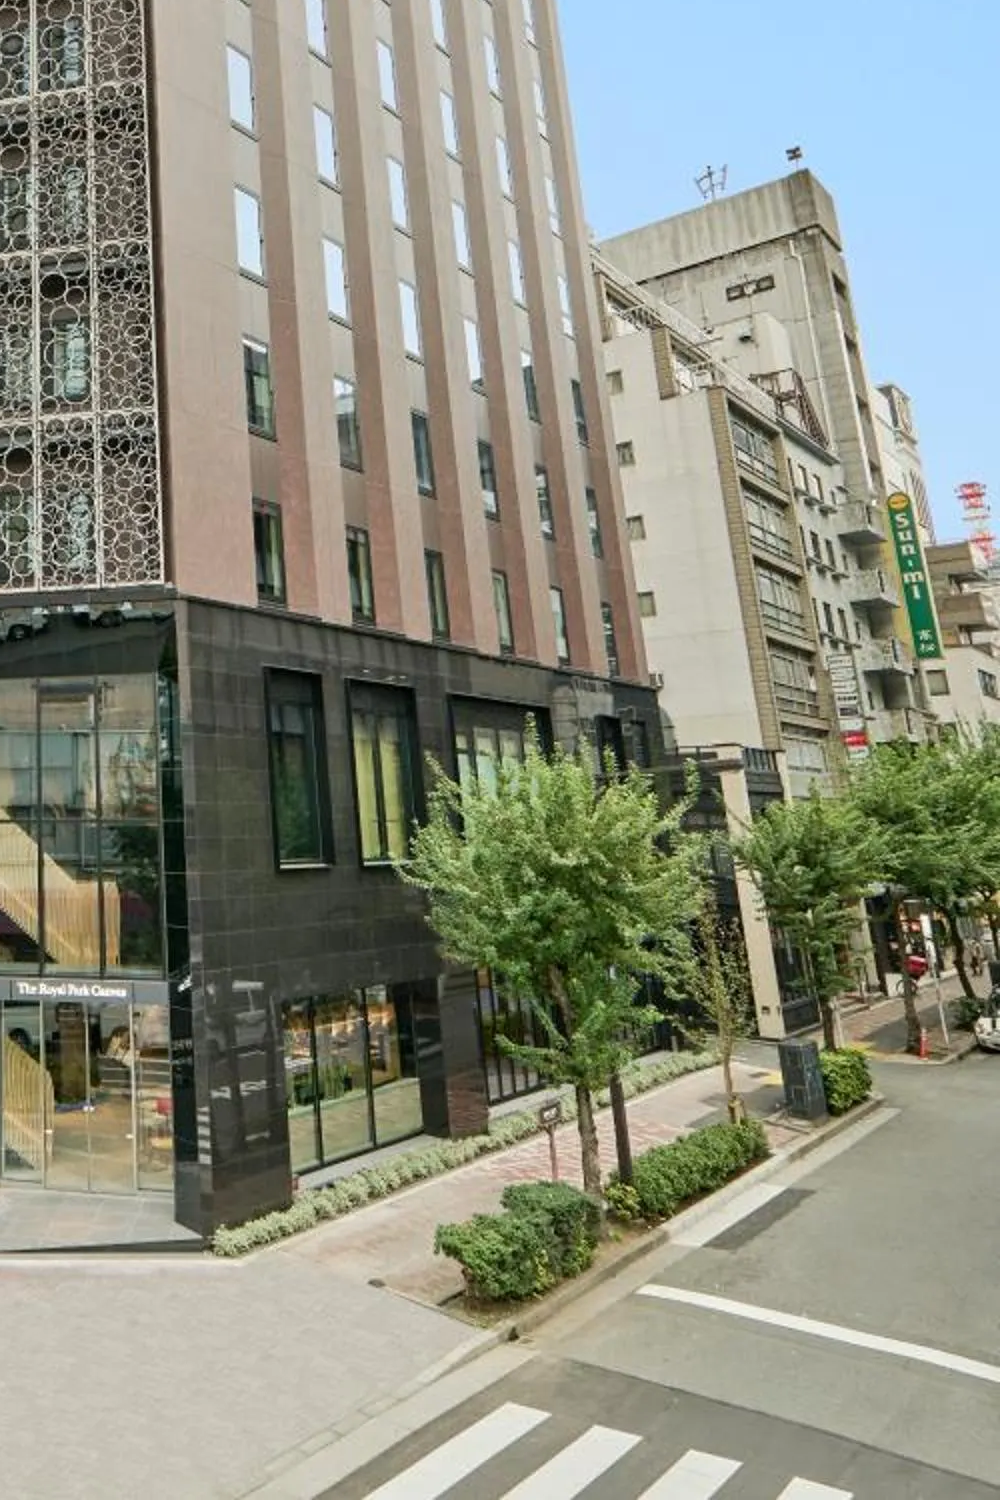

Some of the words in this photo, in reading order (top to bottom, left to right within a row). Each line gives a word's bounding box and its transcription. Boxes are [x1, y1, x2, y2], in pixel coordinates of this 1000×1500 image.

[16, 982, 37, 995] The
[39, 983, 67, 997] Royal
[67, 983, 90, 996] Park
